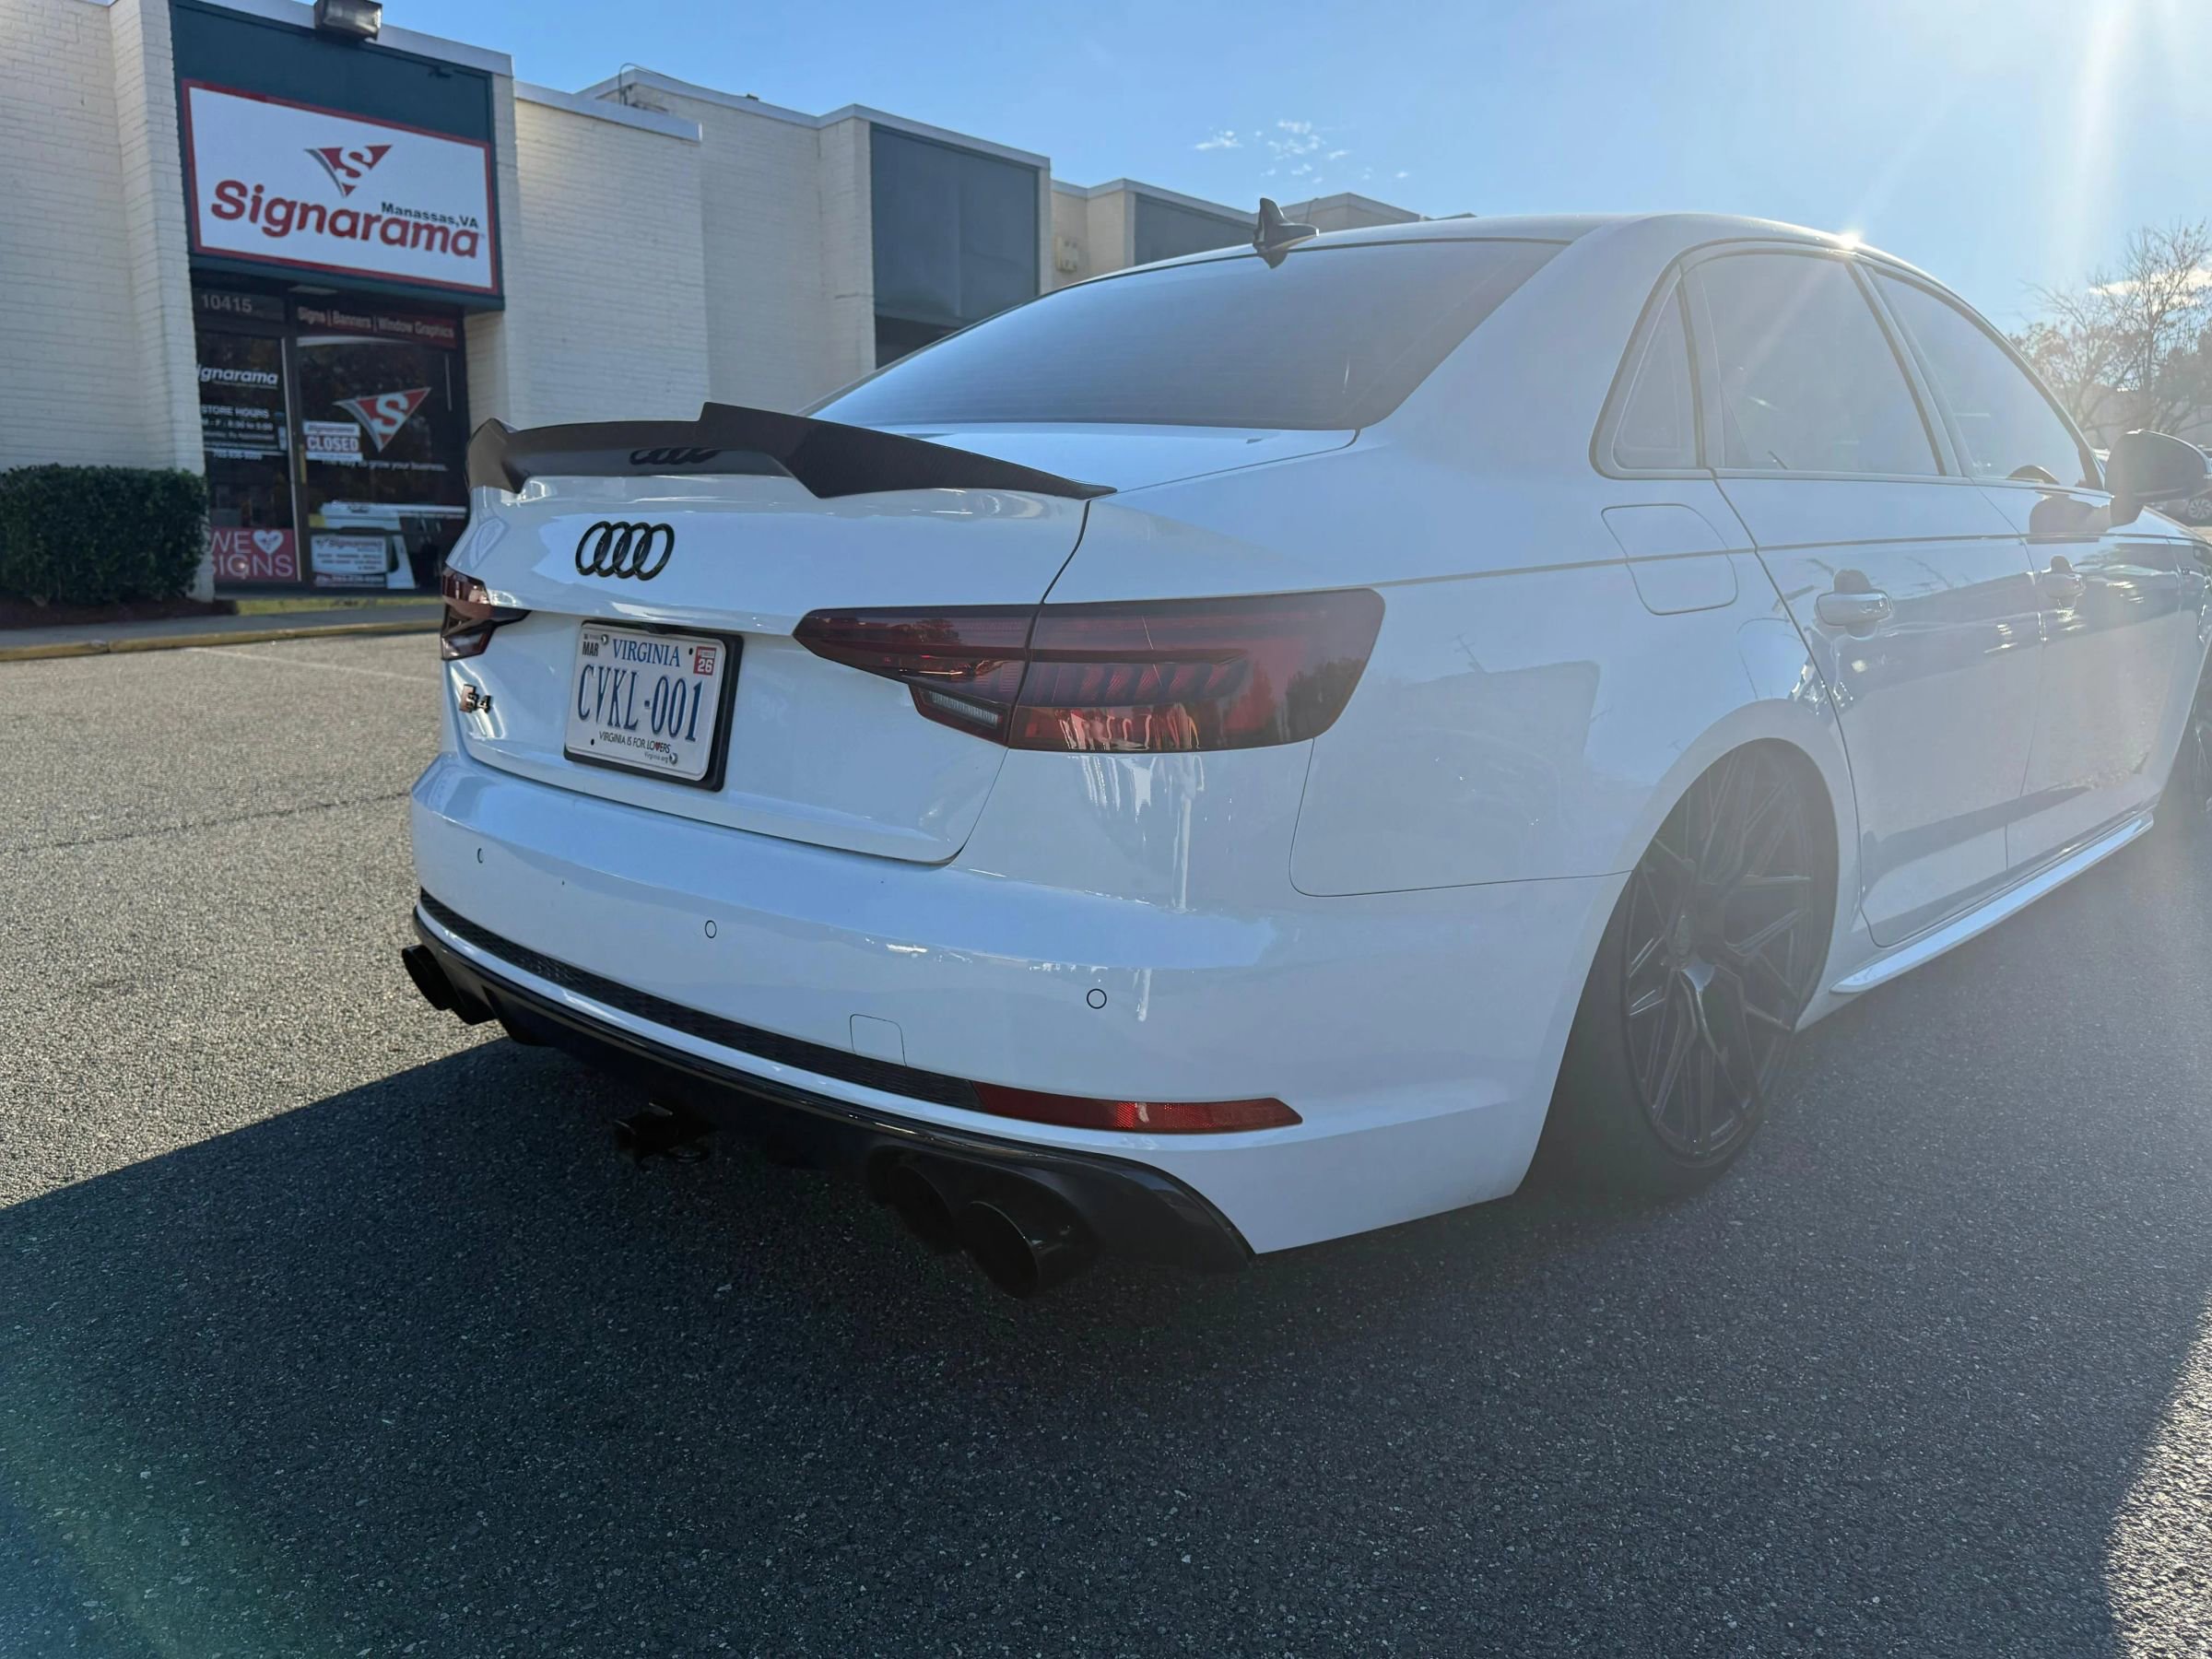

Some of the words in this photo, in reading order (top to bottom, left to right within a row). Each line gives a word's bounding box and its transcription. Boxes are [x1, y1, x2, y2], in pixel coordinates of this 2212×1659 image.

[211, 180, 479, 259] Signarama
[201, 294, 253, 313] 10415
[298, 306, 325, 324] Signs
[333, 310, 371, 328] Banners
[378, 316, 414, 333] Window
[415, 321, 454, 338] Graphics
[196, 364, 278, 385] gnarama
[307, 436, 359, 452] CLOSED
[210, 530, 253, 554] WE
[213, 553, 294, 578] IGNS
[582, 641, 599, 657] MAR
[612, 638, 681, 667] VIRGINIA
[697, 658, 713, 674] 26
[599, 731, 626, 746] VIRGINIA
[627, 736, 632, 747] IS
[633, 738, 646, 749] FOR
